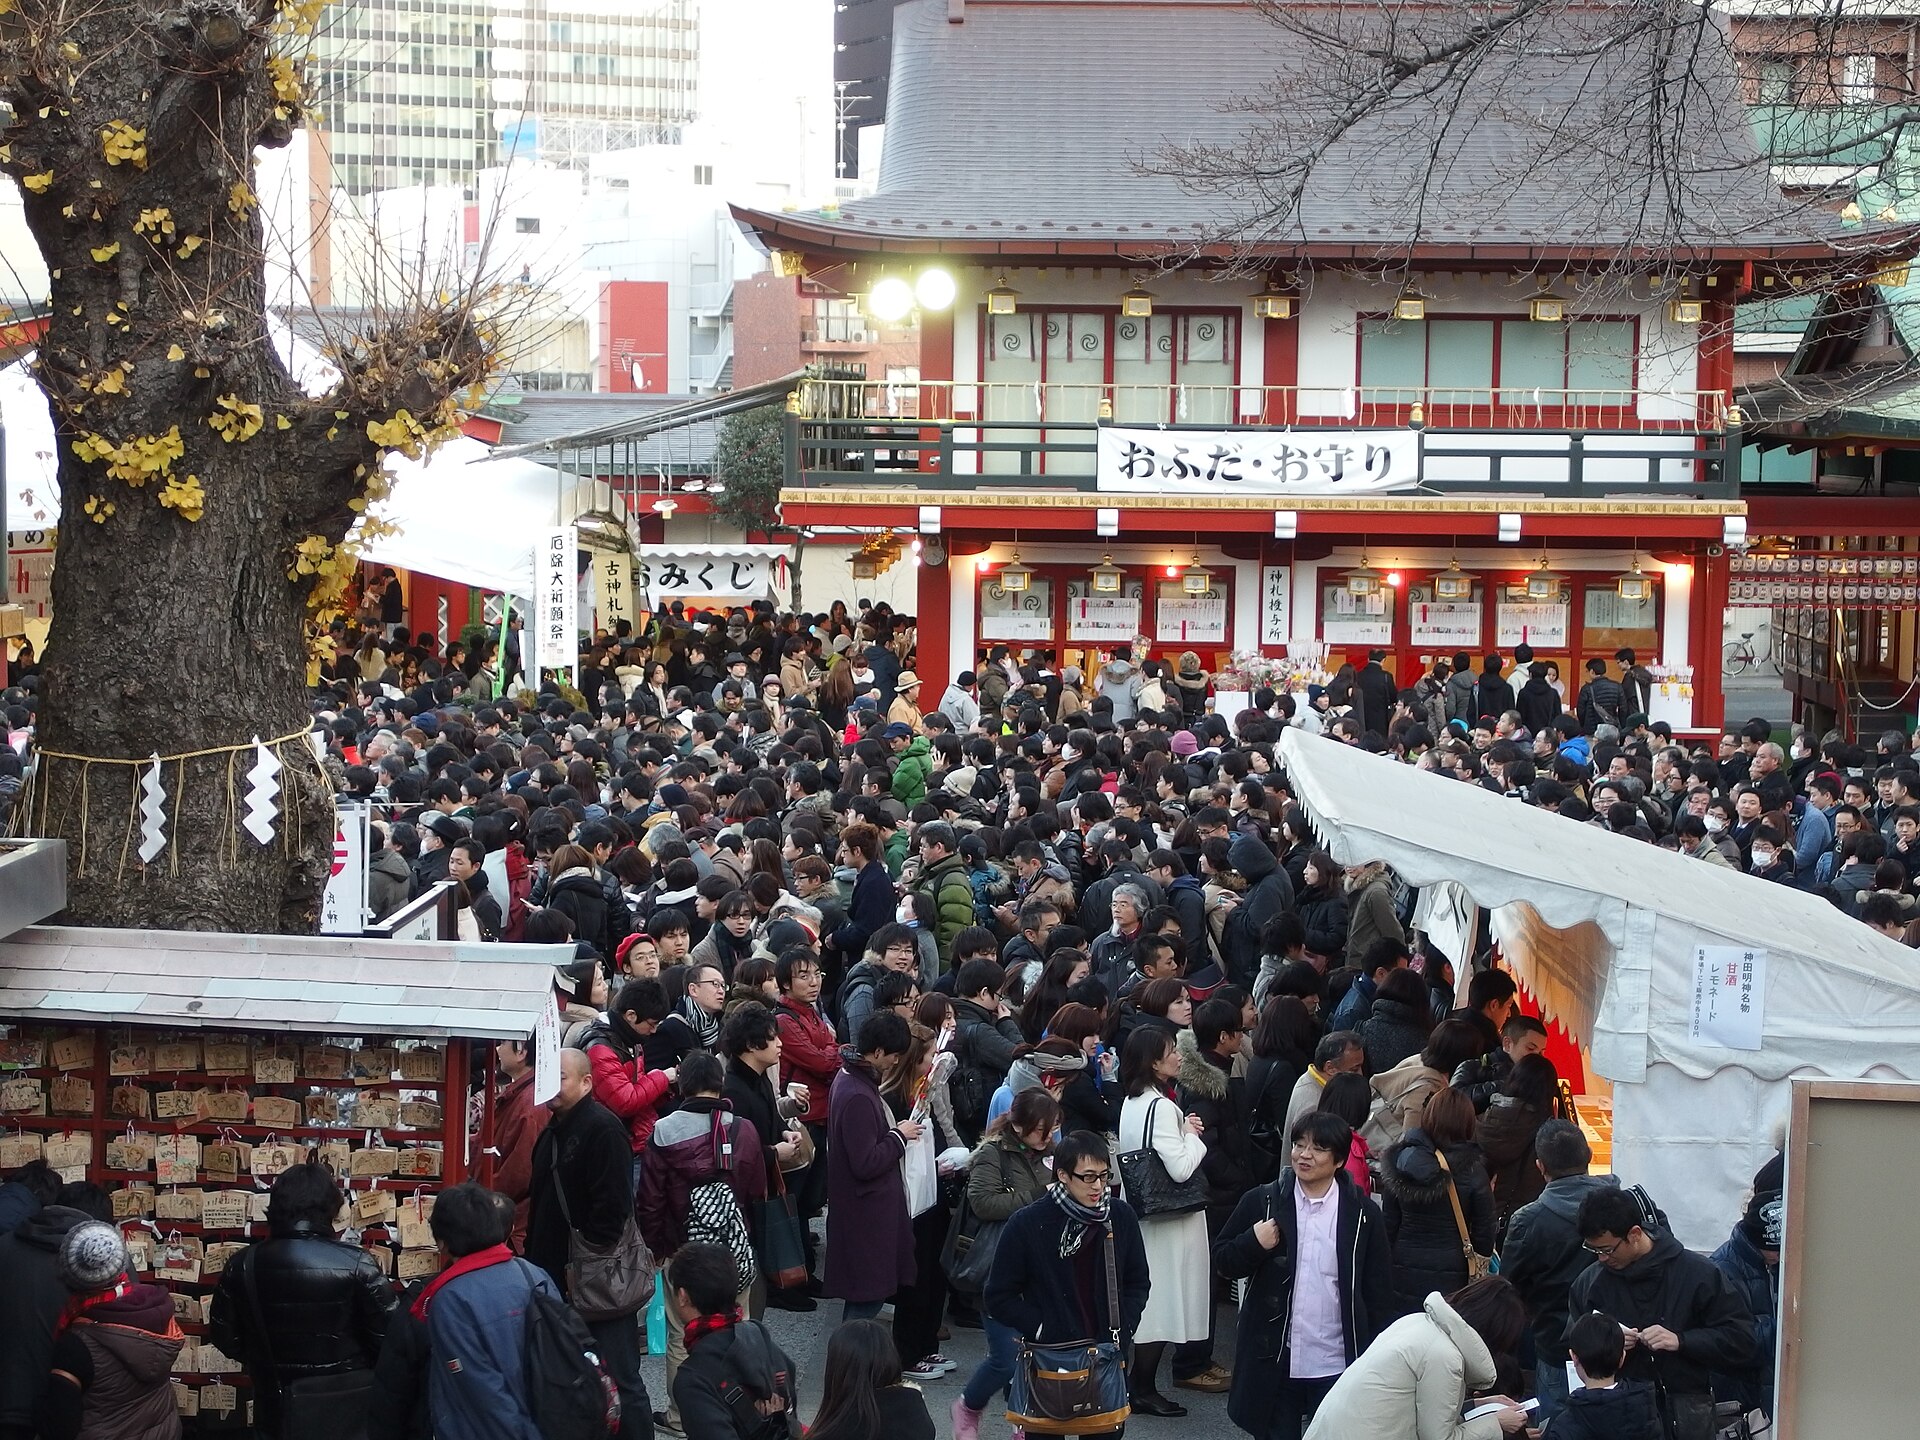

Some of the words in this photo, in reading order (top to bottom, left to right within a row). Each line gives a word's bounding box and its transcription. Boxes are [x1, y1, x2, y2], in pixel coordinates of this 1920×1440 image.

[1118, 440, 1391, 483] おふだ・お守り
[550, 535, 564, 639] 厄除大祈願祭
[1268, 569, 1283, 641] 神札授与所
[1708, 964, 1720, 1022] レモネード
[1725, 963, 1738, 986] 甘酒
[1740, 952, 1754, 1013] 神田明神名物
